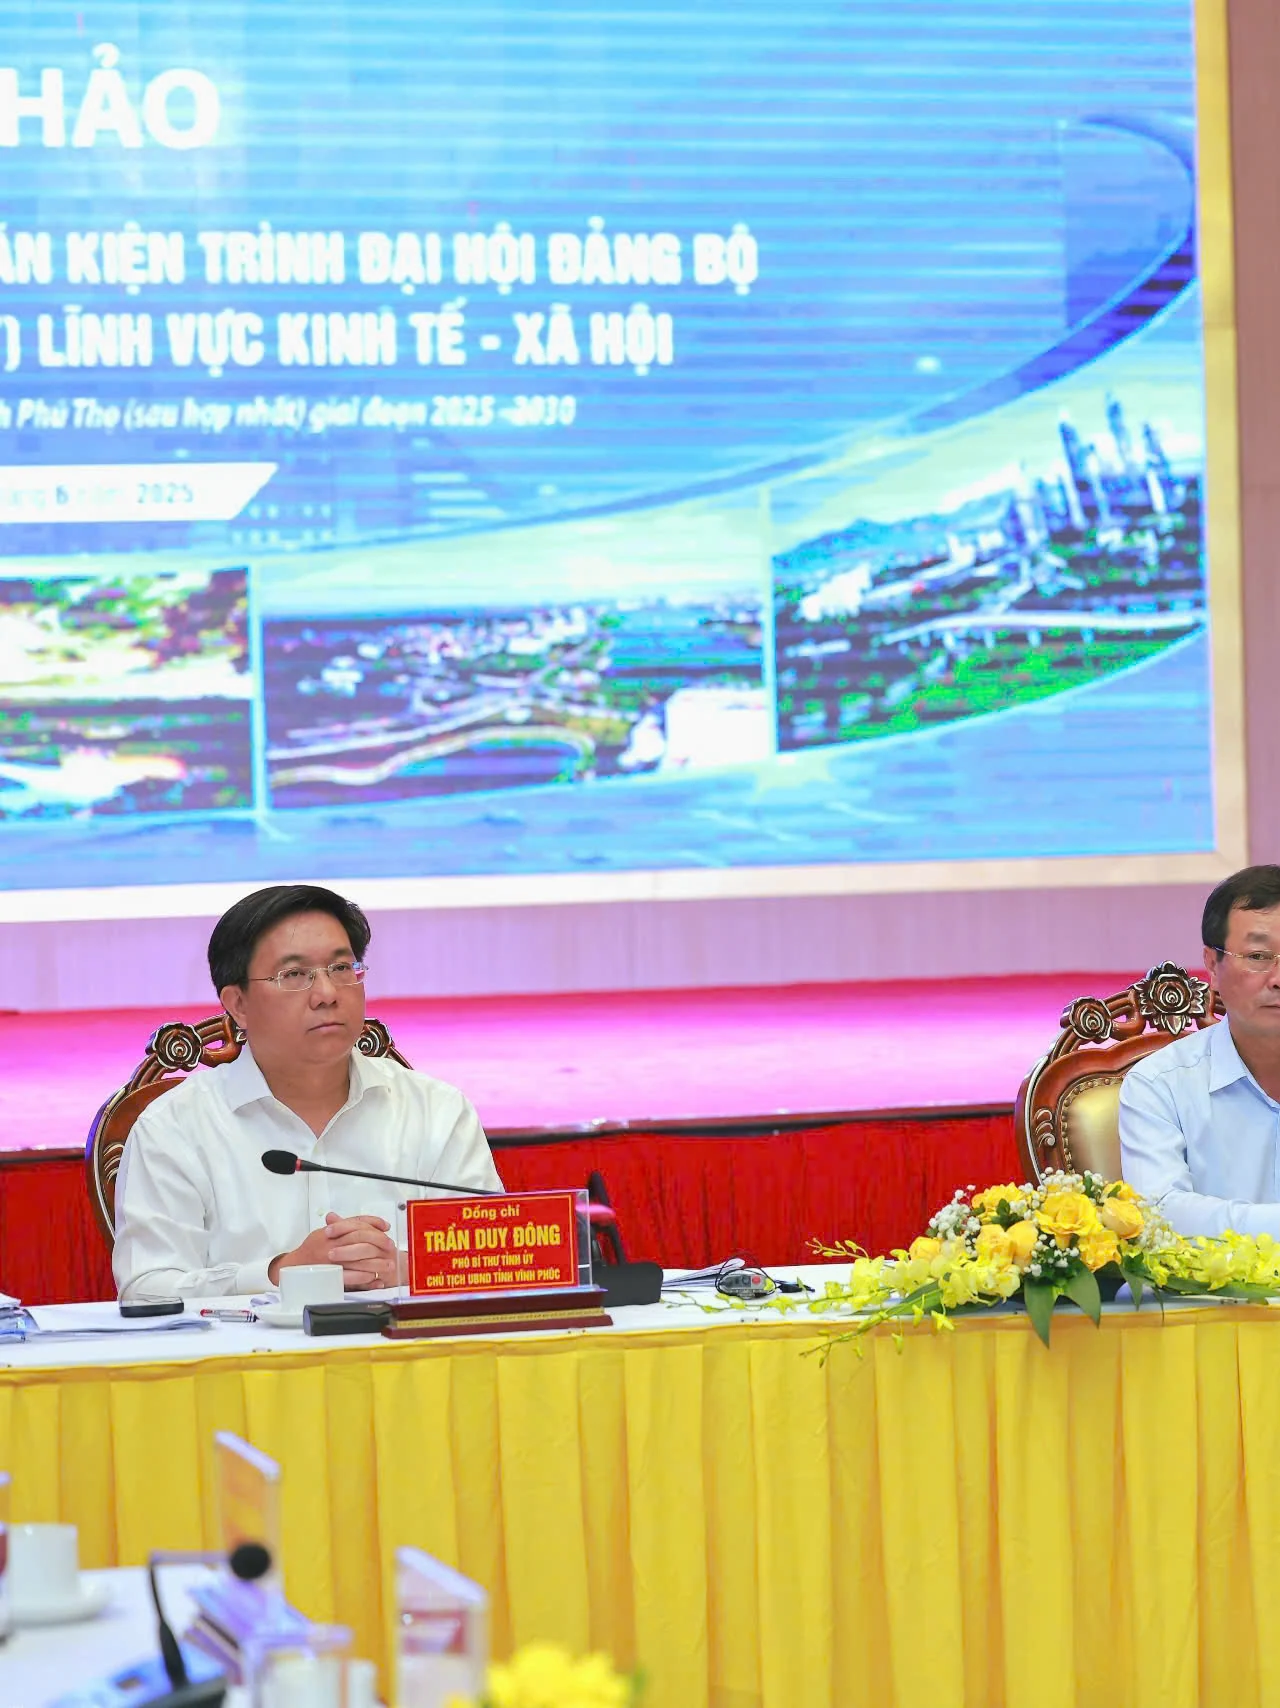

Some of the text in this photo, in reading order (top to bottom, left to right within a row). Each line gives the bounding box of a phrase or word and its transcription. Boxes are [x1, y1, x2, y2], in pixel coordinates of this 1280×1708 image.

[66, 221, 185, 296] KIỆN
[197, 221, 345, 284] TRÌNH
[357, 232, 442, 296] ĐẠI
[454, 221, 536, 295] HỘI
[548, 216, 682, 285] ĐẢNG
[693, 222, 758, 296] BỘ
[37, 304, 152, 367] LĨNH
[165, 308, 265, 378] VỰC
[277, 312, 397, 366] KINH
[407, 296, 467, 365] TẾ
[512, 303, 580, 365] XÃ
[590, 303, 674, 376] HỘI
[16, 398, 69, 430] Phú
[72, 398, 121, 435] Thọ
[182, 396, 233, 434] hợp
[500, 1204, 520, 1217] chí
[424, 1222, 561, 1252] TRẦN DUY ĐÔNG
[482, 1254, 500, 1267] THƯ
[501, 1251, 520, 1266] TỈNH
[523, 1249, 534, 1264] ỦY
[426, 1267, 560, 1288] CHỦ TỊCH UBND TỈNH VĨNH PHÚC
